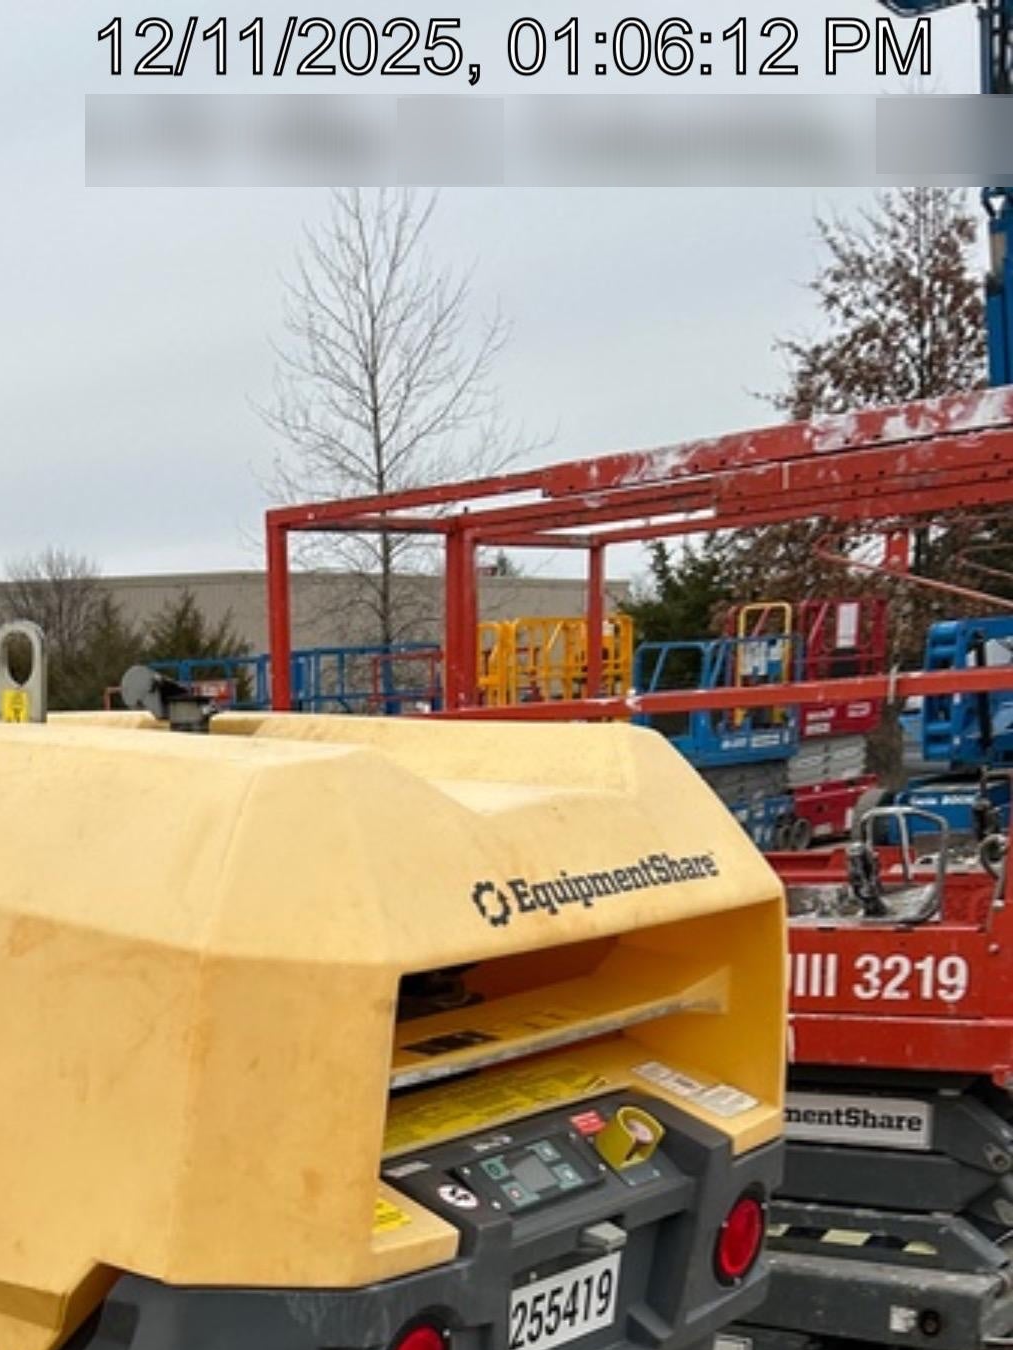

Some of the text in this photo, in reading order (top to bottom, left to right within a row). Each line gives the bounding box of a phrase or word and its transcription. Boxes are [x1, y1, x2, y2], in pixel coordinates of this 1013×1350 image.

[506, 852, 720, 915] EquipmentShare
[852, 953, 970, 1004] 3219
[508, 1268, 613, 1350] 255419
